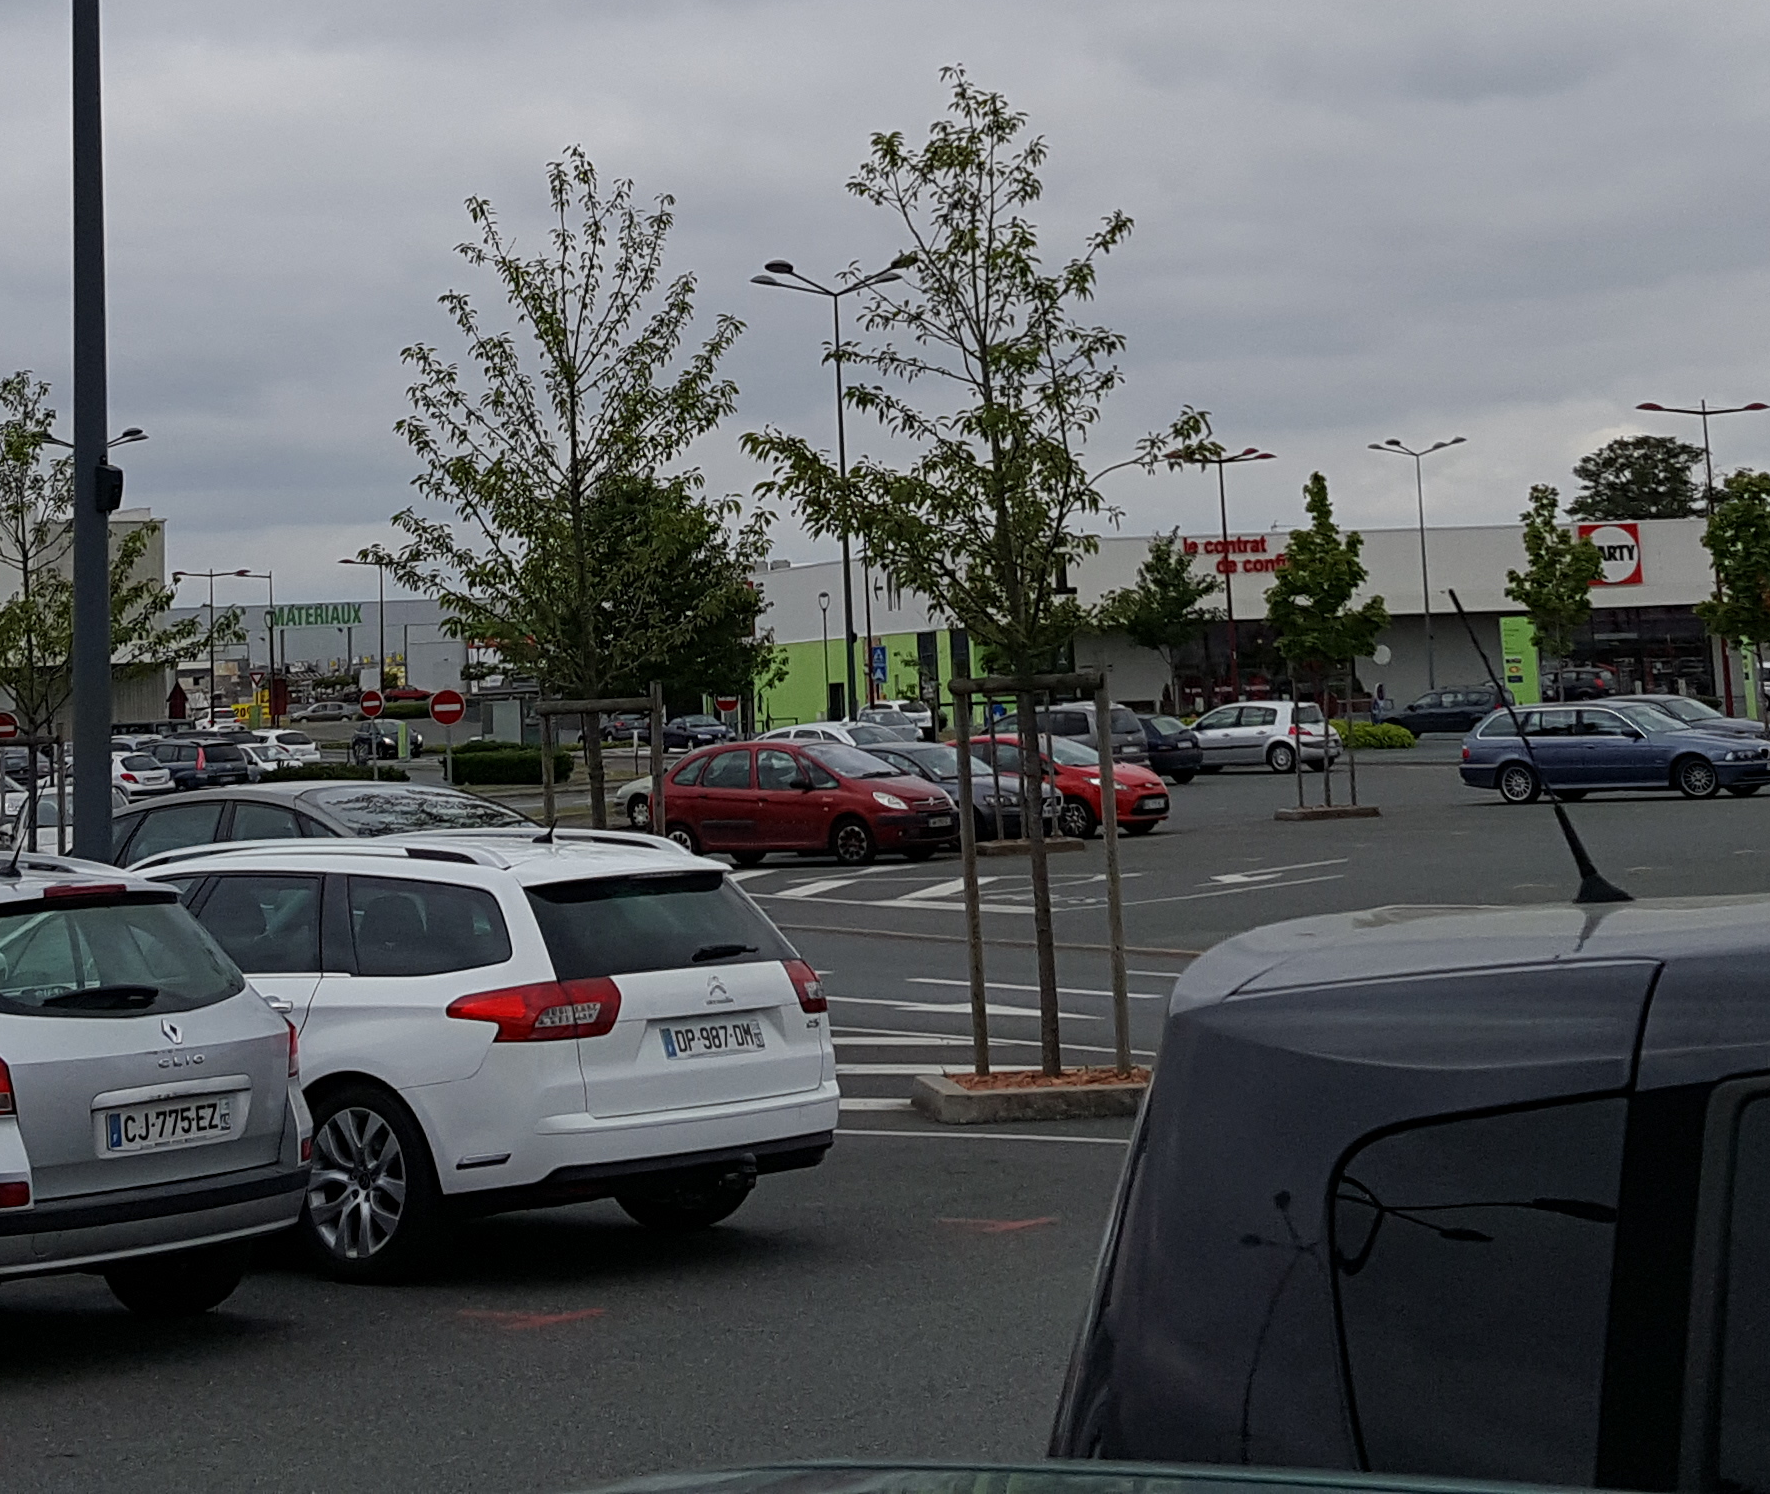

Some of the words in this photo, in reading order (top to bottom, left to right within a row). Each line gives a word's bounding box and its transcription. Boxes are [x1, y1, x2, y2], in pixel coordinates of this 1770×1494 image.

[1183, 537, 1199, 555] le
[1204, 535, 1267, 554] contrat
[1597, 545, 1635, 561] ARTY
[1216, 555, 1238, 574] de
[1243, 553, 1287, 573] confi
[675, 1023, 754, 1053] DP-987-DM
[158, 1054, 205, 1068] CLIO
[123, 1103, 219, 1143] CJ-775-EZ
